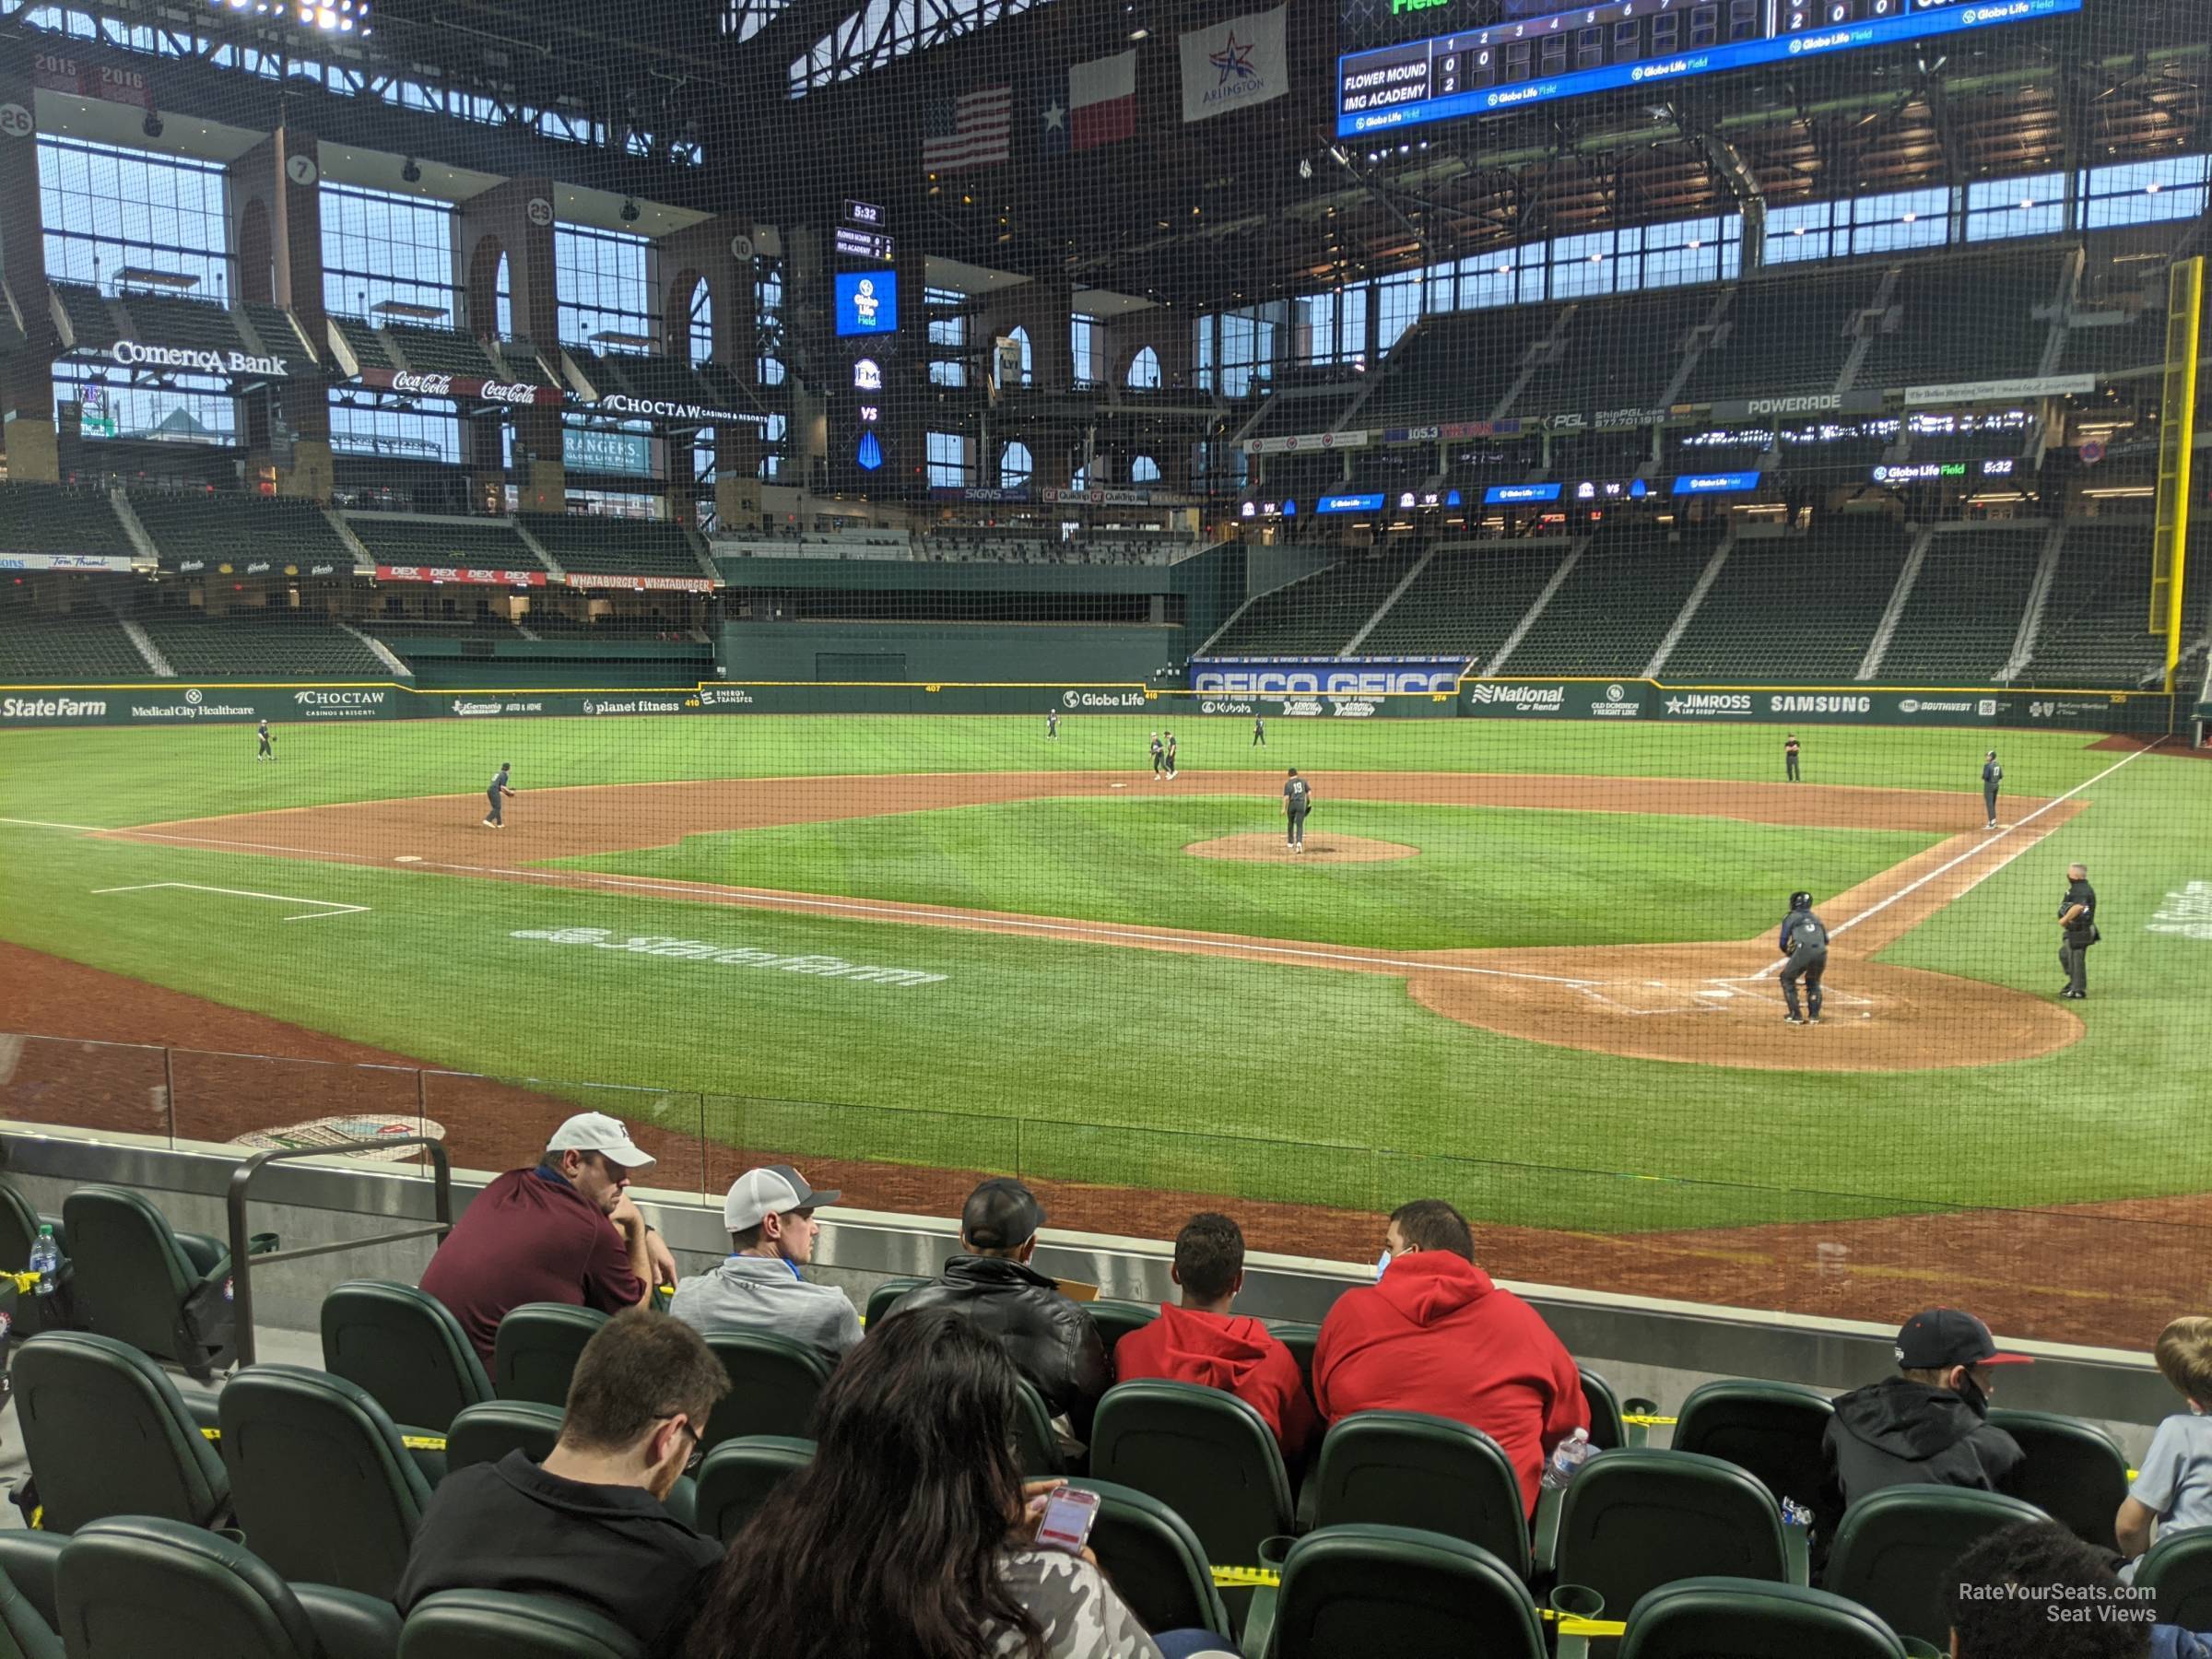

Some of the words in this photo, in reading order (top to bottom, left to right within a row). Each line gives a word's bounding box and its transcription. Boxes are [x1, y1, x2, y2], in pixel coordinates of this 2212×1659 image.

[1977, 6, 2007, 20] Globe
[2008, 3, 2029, 16] Life
[2030, 0, 2054, 12] Field
[1448, 39, 1453, 51] 1
[1480, 32, 1488, 44] 2
[1515, 25, 1524, 37] 3
[1550, 18, 1559, 29] 4
[1586, 11, 1594, 23] 5
[1623, 3, 1632, 16] 6
[1802, 36, 1830, 52] Globe
[1830, 32, 1850, 46] Life
[1851, 29, 1873, 42] Field
[1344, 96, 1367, 112] IMG
[1369, 83, 1426, 107] ACADEMY
[1444, 77, 1454, 92] 2
[1792, 13, 1803, 29] 2
[1833, 6, 1844, 21] 0
[1876, 0, 1888, 14] 0
[35, 53, 76, 76] 2015
[1345, 70, 1385, 91] FLOWER
[1386, 62, 1427, 82] MOUND
[1446, 58, 1454, 72] 0
[1479, 52, 1488, 65] 0
[1643, 66, 1669, 78] Globe
[1669, 61, 1687, 73] Life
[101, 66, 144, 88] 2016
[1203, 77, 1265, 104] ARLINGTON
[1499, 91, 1522, 103] Globe
[1523, 88, 1538, 100] Life
[2, 110, 29, 131] 26
[1365, 115, 1387, 127] Globe
[1388, 110, 1402, 124] Life
[297, 160, 308, 179] 7
[530, 203, 550, 220] 29
[854, 205, 877, 221] 5:32
[848, 243, 871, 255] ACADEMY
[853, 294, 879, 308] Globe
[858, 305, 875, 317] Life
[857, 315, 877, 326] Field
[228, 351, 288, 376] Bank
[614, 394, 701, 418] CHOCTAW
[701, 409, 732, 419] CASINOS
[738, 413, 768, 424] RESORTS
[1748, 394, 1842, 415] POWERADE
[861, 406, 877, 421] VS
[1554, 415, 1588, 428] PGL
[1594, 407, 1665, 420] ShipPGL.com
[1408, 427, 1438, 441] 105.3
[565, 437, 636, 456] RANGERS
[1888, 466, 1919, 478] Globe
[1920, 465, 1940, 477] Life
[1940, 463, 1965, 477] Field
[1983, 461, 2013, 473] 5:32
[964, 488, 1003, 500] SIGNS
[1606, 483, 1620, 494] VS
[1105, 492, 1135, 502] QuikTrip
[1424, 494, 1438, 504] VS
[1264, 502, 1276, 513] VS
[49, 556, 73, 566] Tom
[73, 555, 110, 567] Thumb
[391, 566, 419, 576] DEX
[429, 568, 457, 577] DEX
[467, 570, 495, 579] DEX
[504, 571, 531, 581] DEX
[571, 574, 640, 588] WHATABURGER
[644, 577, 710, 591] WHATABURGER
[1195, 673, 1319, 701] GEICO
[1327, 673, 1460, 702] GEICO
[303, 691, 384, 704] CHOCTAW
[684, 699, 700, 708] 410
[716, 696, 753, 704] TRANSFER
[1082, 693, 1120, 707] Globe
[1122, 692, 1146, 706] Life
[1770, 696, 1871, 713] SAMSUNG
[132, 705, 174, 717] Medical
[175, 705, 197, 719] City
[198, 705, 254, 717] Healthcare
[466, 702, 502, 711] Germania
[505, 703, 521, 712] AUTO
[526, 702, 543, 712] HOME
[595, 700, 637, 715] planet
[638, 700, 679, 712] fitness
[1217, 702, 1253, 713] Kubota
[1516, 703, 1532, 712] Car
[1532, 702, 1560, 712] Rental
[1921, 701, 1972, 712] SOUTHWEST
